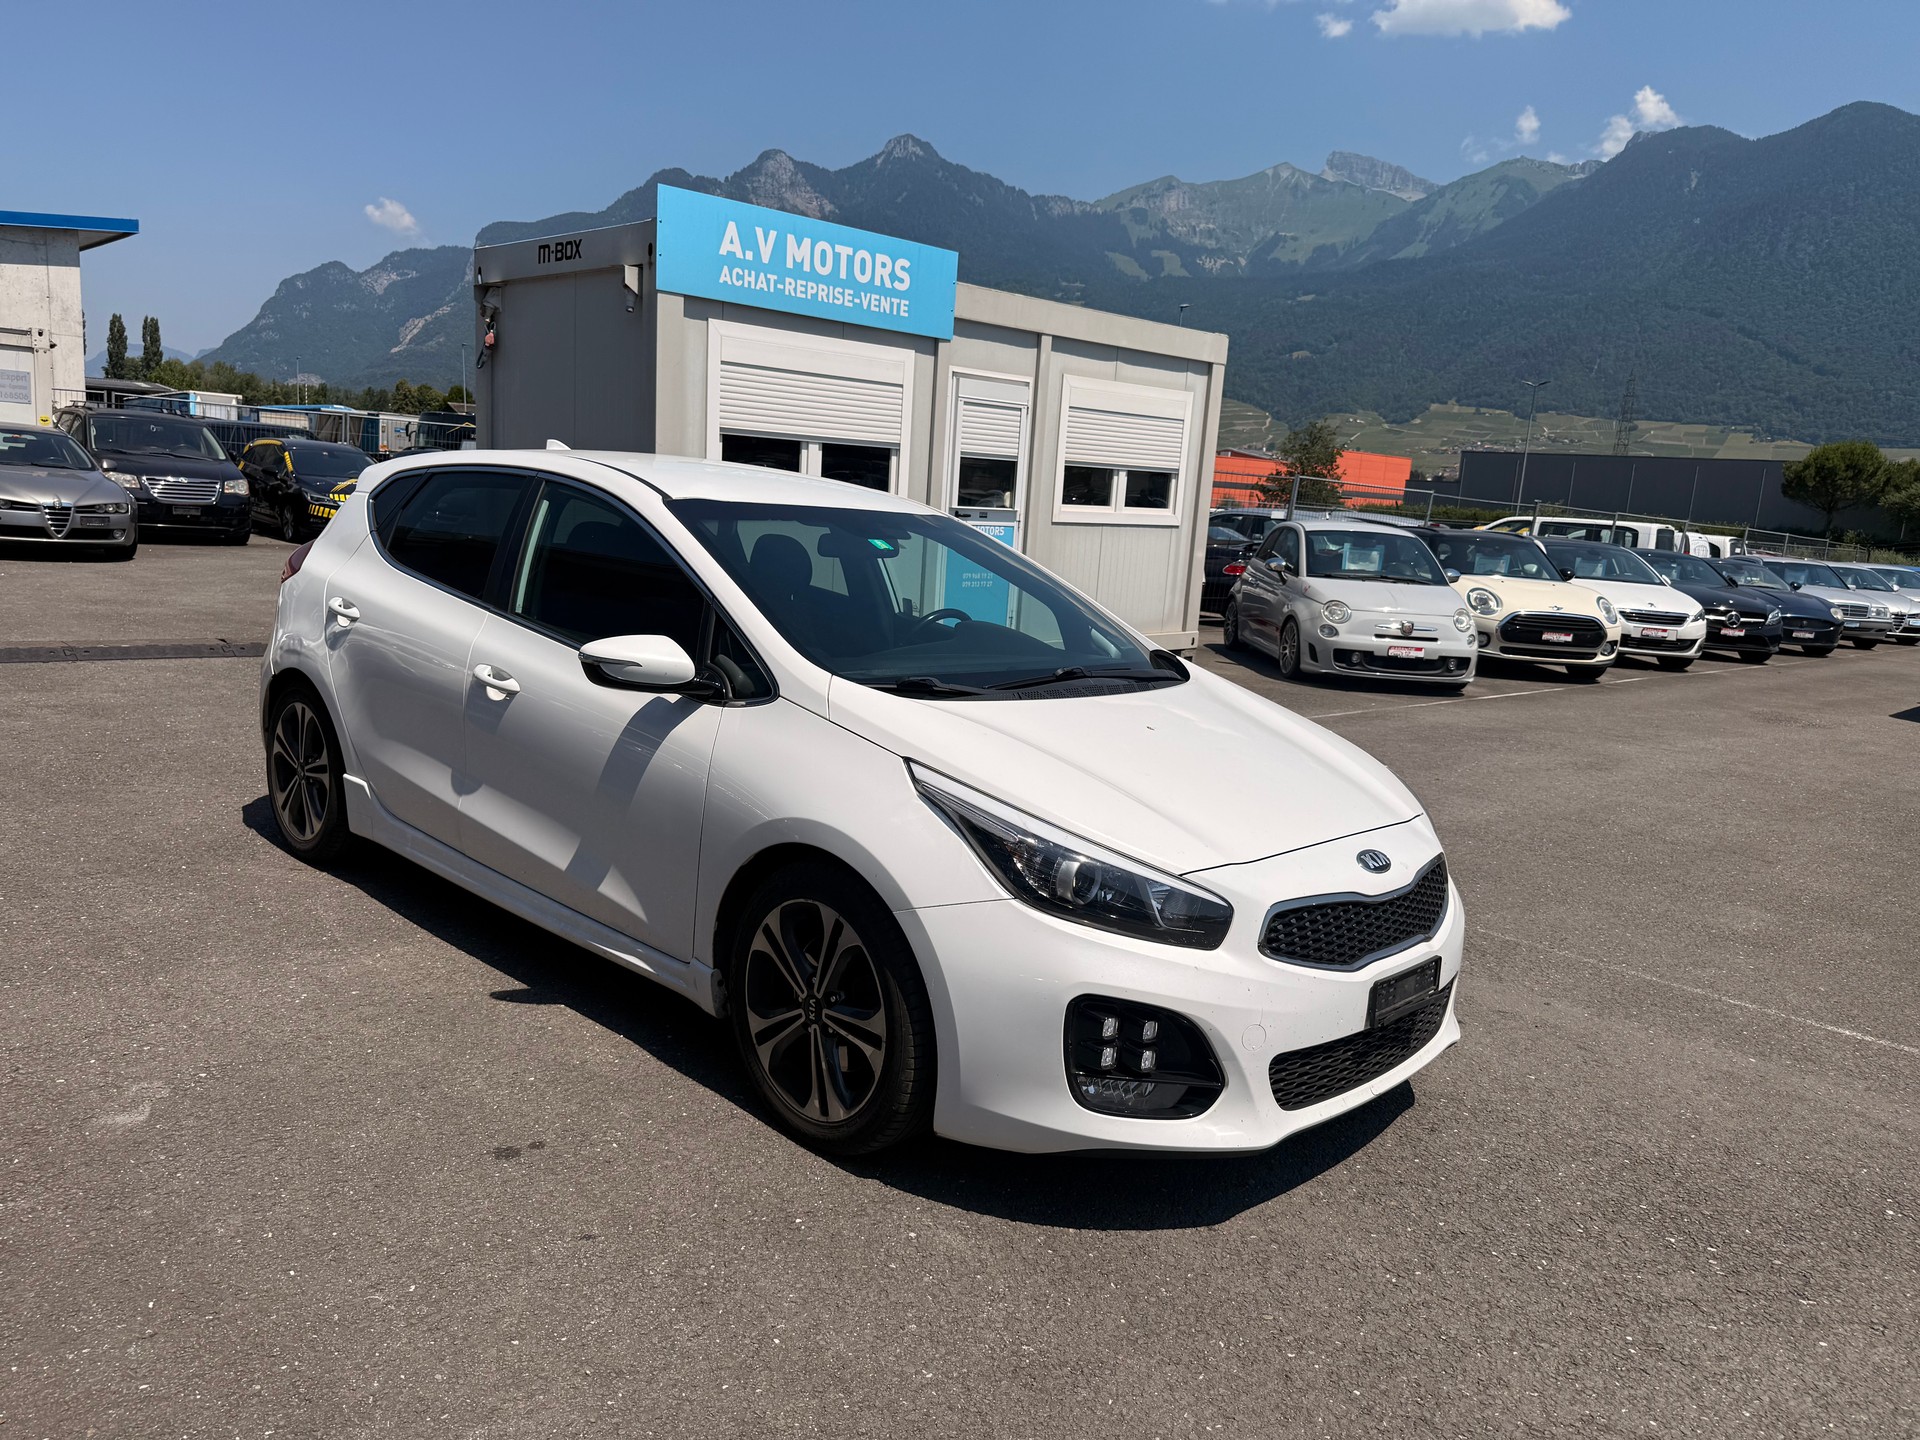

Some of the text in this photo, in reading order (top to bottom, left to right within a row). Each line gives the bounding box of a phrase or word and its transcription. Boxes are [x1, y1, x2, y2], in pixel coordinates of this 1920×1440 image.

[718, 221, 911, 291] A.V MOTORS
[719, 265, 910, 317] ACHAT-REPRISE-VENTE
[1360, 851, 1390, 869] KIA
